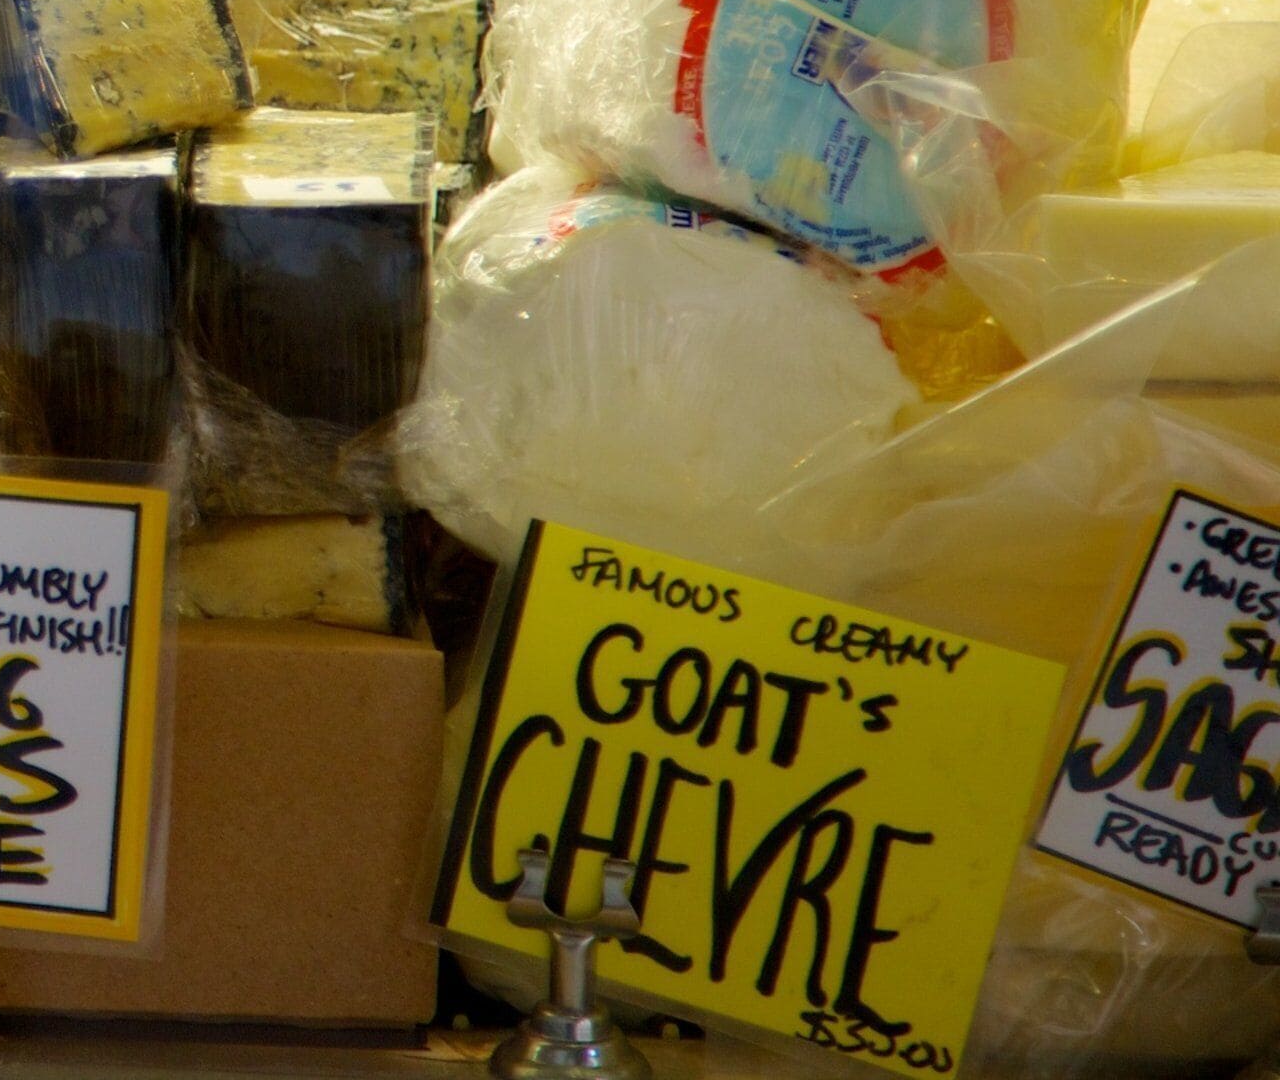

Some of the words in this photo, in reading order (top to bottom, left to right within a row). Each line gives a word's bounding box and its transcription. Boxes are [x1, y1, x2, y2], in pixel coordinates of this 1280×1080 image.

[570, 546, 742, 623] FAMOUS
[790, 613, 970, 674] CREAMY
[469, 714, 936, 1034] CHEVRE
[1094, 811, 1255, 898] READY
